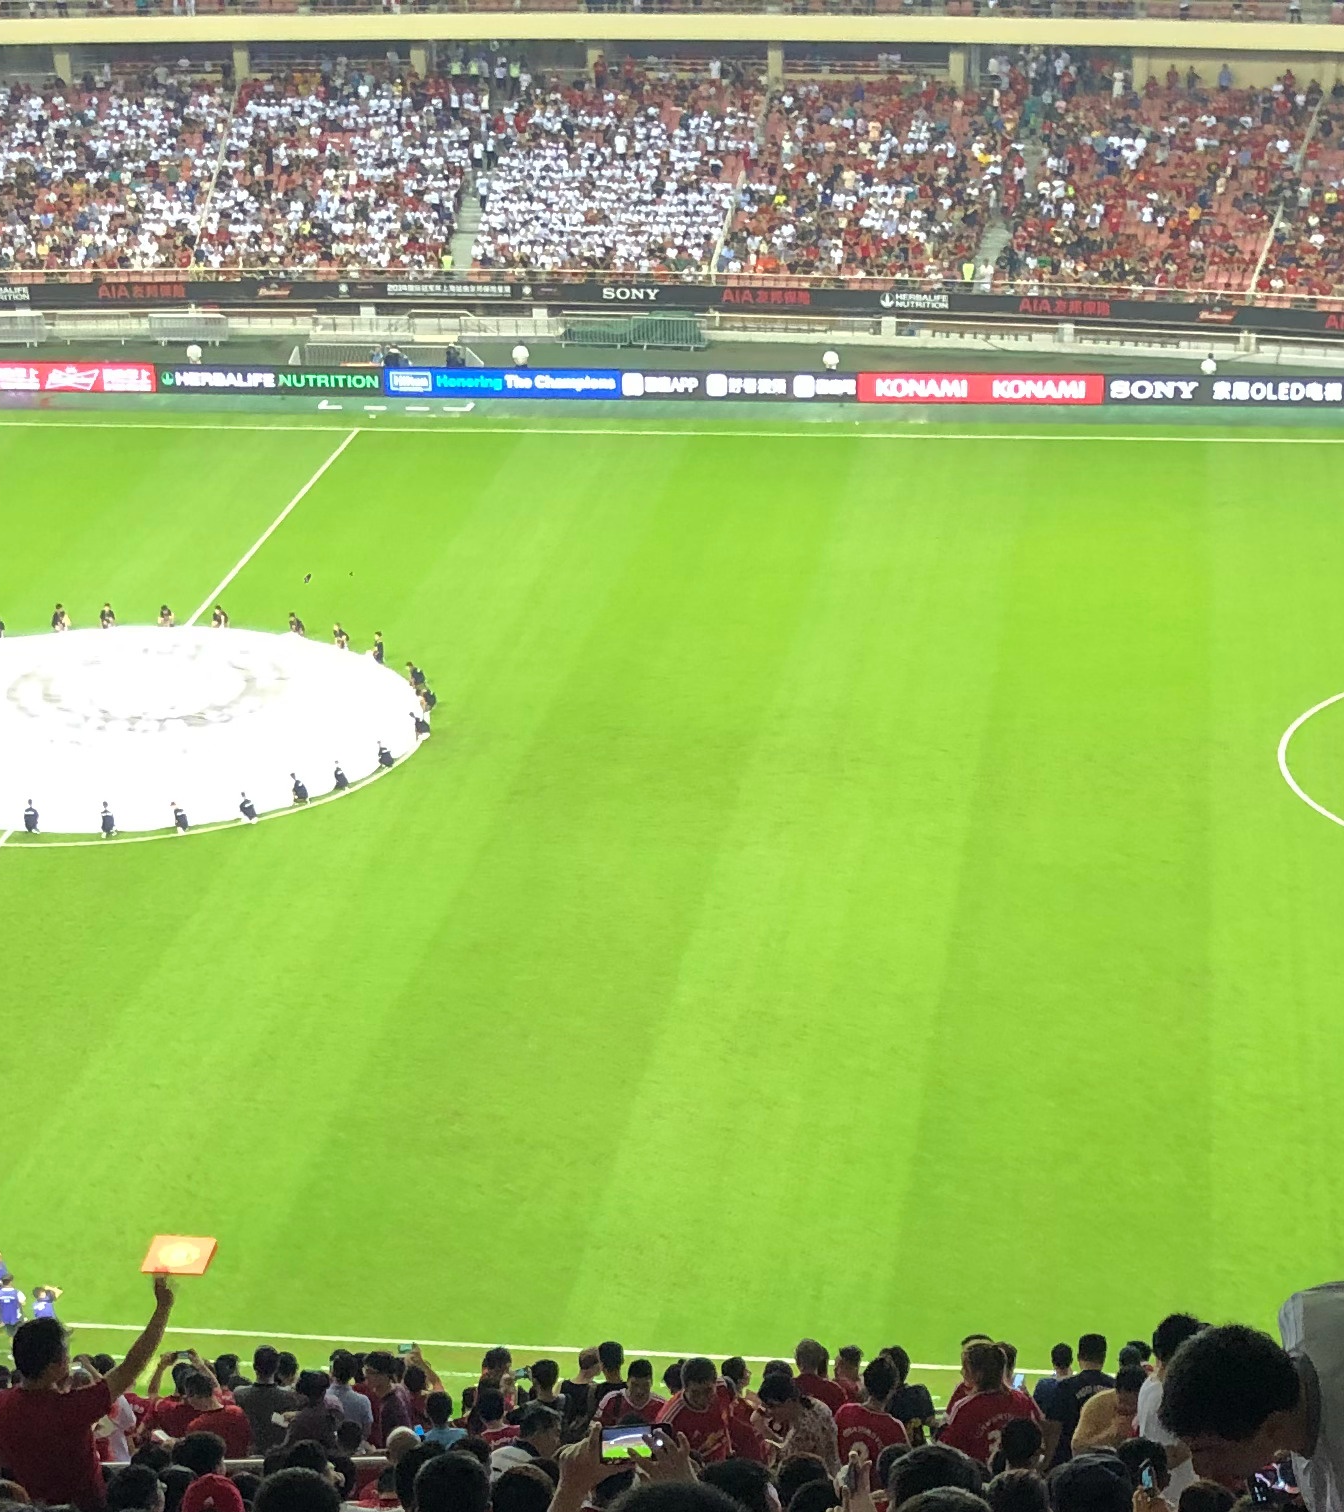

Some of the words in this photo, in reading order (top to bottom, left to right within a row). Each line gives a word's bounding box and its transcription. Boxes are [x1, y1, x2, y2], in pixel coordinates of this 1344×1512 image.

[602, 288, 659, 300] SONY
[174, 371, 275, 389] HERBALIFE
[278, 374, 379, 389] NUTRITION
[436, 375, 503, 391] Honoring
[504, 374, 533, 389] The
[534, 374, 616, 391] Champions
[876, 379, 968, 398] KONAMI
[992, 379, 1086, 399] KONAMI
[1109, 380, 1199, 399] SONY
